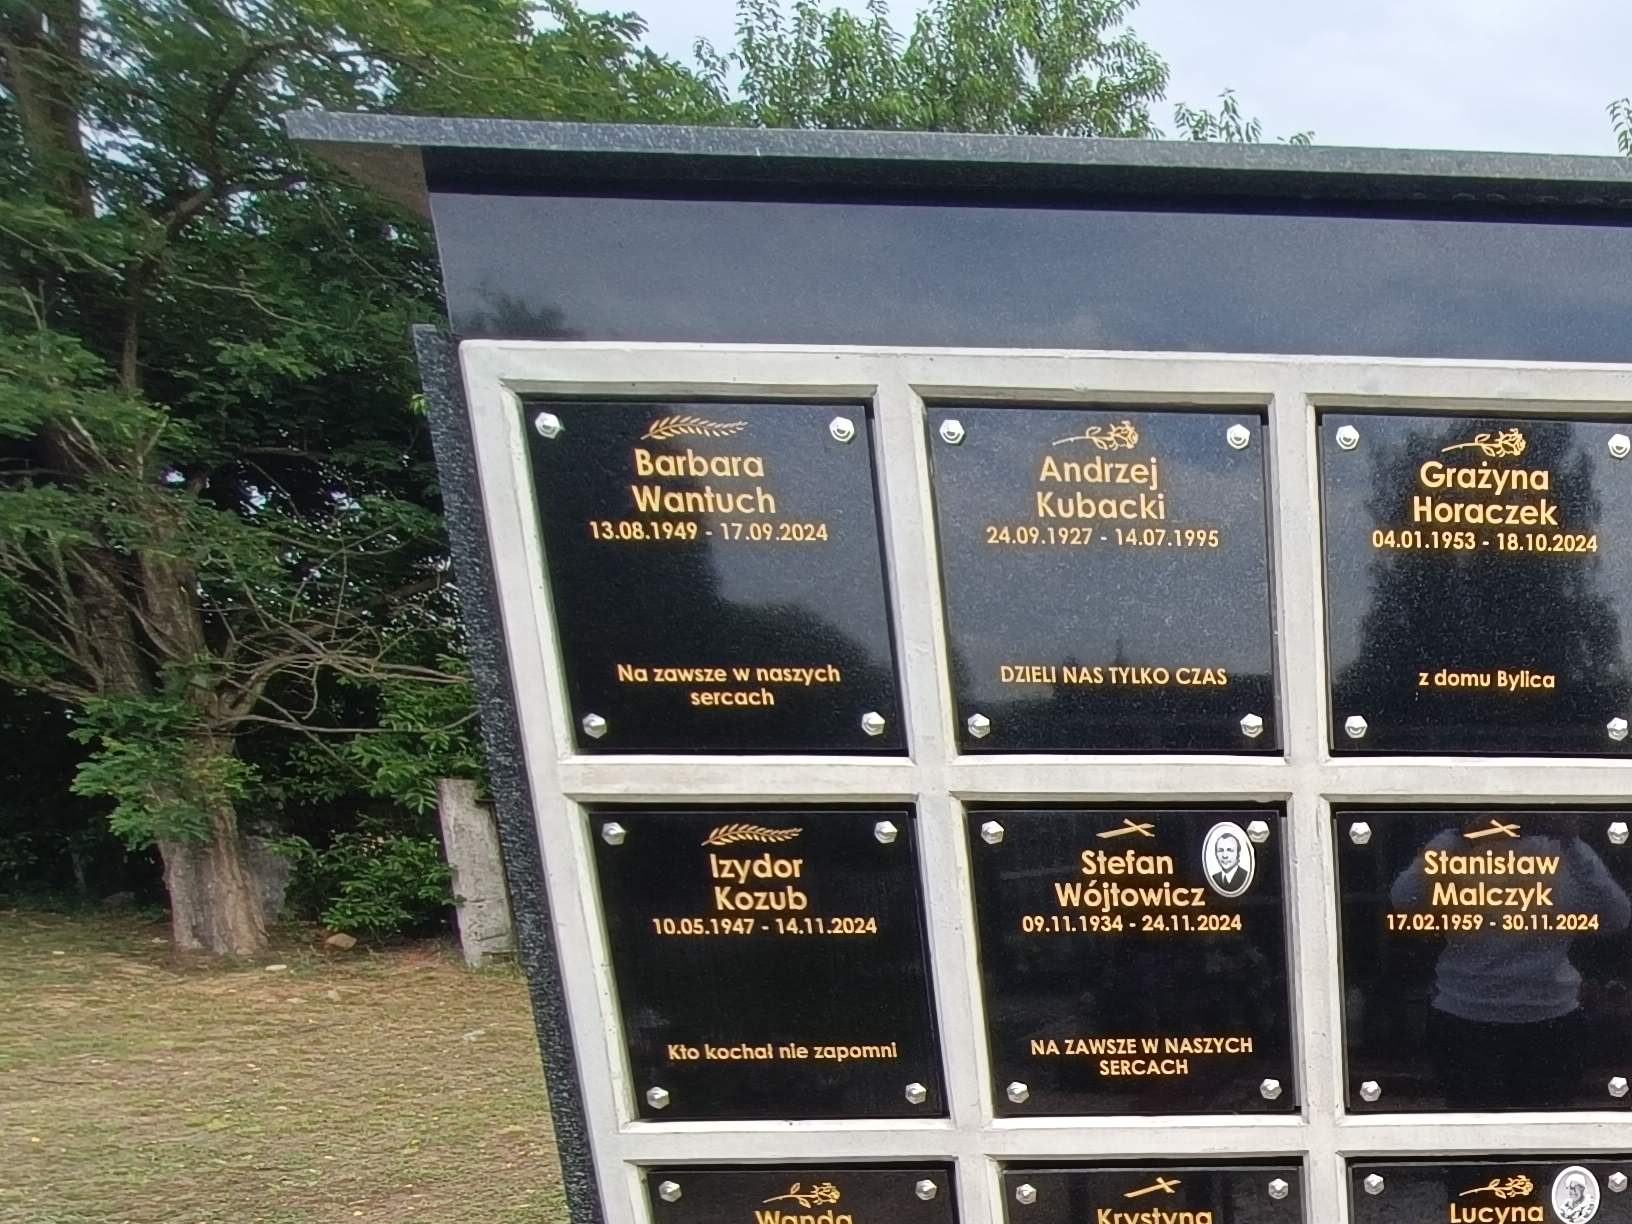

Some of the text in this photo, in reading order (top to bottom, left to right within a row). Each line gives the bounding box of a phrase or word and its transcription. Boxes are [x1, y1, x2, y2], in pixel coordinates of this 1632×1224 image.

[633, 447, 766, 479] Barbara
[1038, 454, 1159, 492] Andrzej
[1418, 459, 1550, 497] Grażyna
[630, 484, 777, 515] Wantuch
[1035, 490, 1166, 521] Kubacki
[1412, 494, 1559, 527] Horaczek
[590, 521, 829, 542] 13.08.1949 17.09.2024
[985, 524, 1220, 549] 24.09.1927 14.07.1995
[1371, 528, 1600, 554] 04.01.1953 18.10.2024
[617, 663, 842, 688] Na zawsze w naszych
[1000, 665, 1228, 686] DZIELI NAS TYLKO CZAS
[1418, 668, 1556, 693] z domu Bylica
[690, 687, 775, 706] sercach
[708, 851, 805, 886] Izydor
[1080, 848, 1175, 876] Stefan
[1423, 848, 1561, 876] Stanisław
[713, 884, 809, 912] Kozub
[1053, 877, 1208, 914] Wójtowicz
[1431, 880, 1555, 913] Malczyk
[652, 916, 878, 935] 10.05.1947 14.11.2024
[1022, 913, 1243, 933] 09.11.1934 24.11.2024
[1386, 913, 1600, 931] 17.02.1959 30.11.2024
[667, 1040, 899, 1064] Kto kochał nie zapomni
[1030, 1037, 1253, 1056] NA ZAWSZE NASZYCH
[1099, 1058, 1189, 1076] SERCACH
